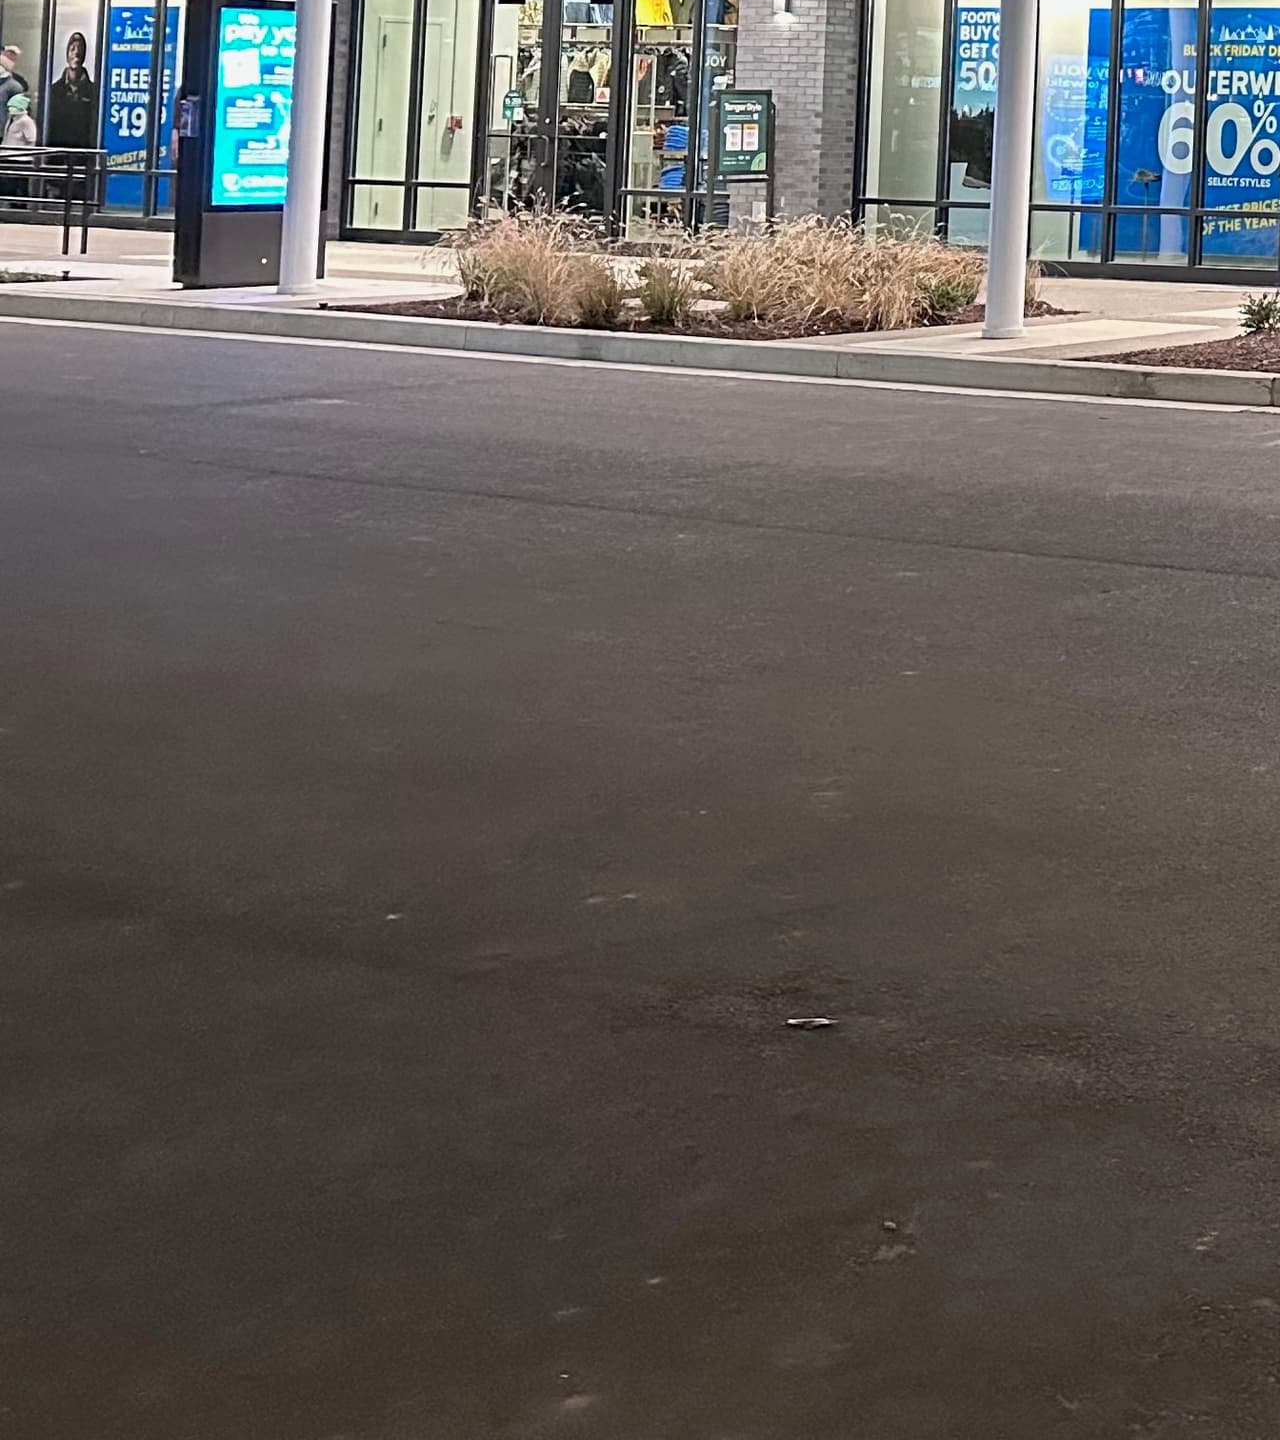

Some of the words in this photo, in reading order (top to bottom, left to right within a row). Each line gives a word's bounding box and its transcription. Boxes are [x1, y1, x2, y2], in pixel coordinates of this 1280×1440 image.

[960, 25, 991, 41] BUY
[960, 43, 989, 58] GET
[1184, 45, 1221, 57] BLCK
[1225, 45, 1266, 57] FRIDAY
[111, 67, 171, 89] FLEEE
[110, 91, 150, 104] STARTIN
[1207, 177, 1238, 187] SELECT
[1239, 178, 1271, 188] STYLES
[1217, 218, 1241, 233] THE
